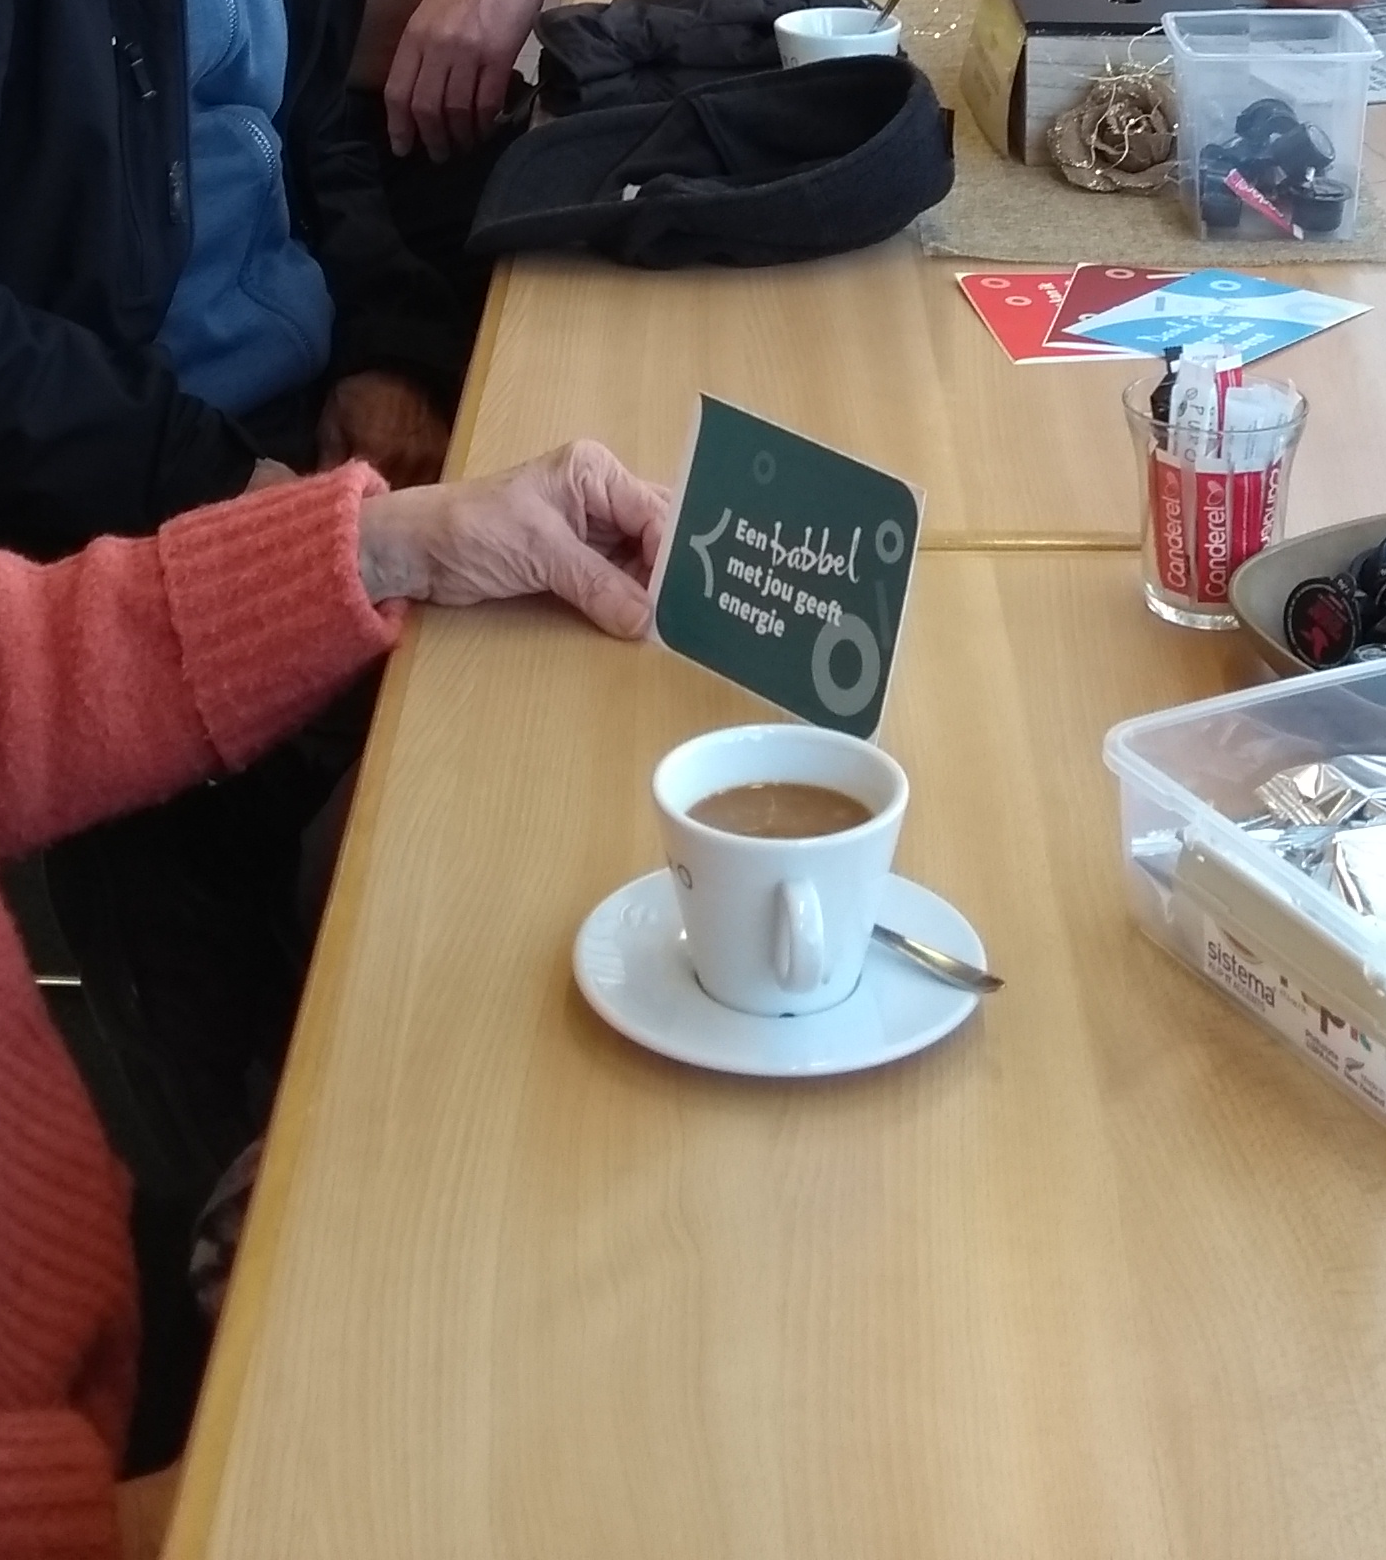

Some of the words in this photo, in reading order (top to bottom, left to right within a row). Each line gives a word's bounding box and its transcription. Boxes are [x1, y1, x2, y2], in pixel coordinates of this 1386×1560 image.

[735, 519, 767, 552] Een
[770, 521, 862, 583] babbel
[1164, 497, 1185, 589] Canderel
[1204, 506, 1226, 597] Canderel
[719, 591, 785, 638] energie
[727, 556, 762, 588] met
[761, 569, 794, 602] jou
[794, 591, 843, 626] geeft
[1208, 941, 1276, 1008] sistema
